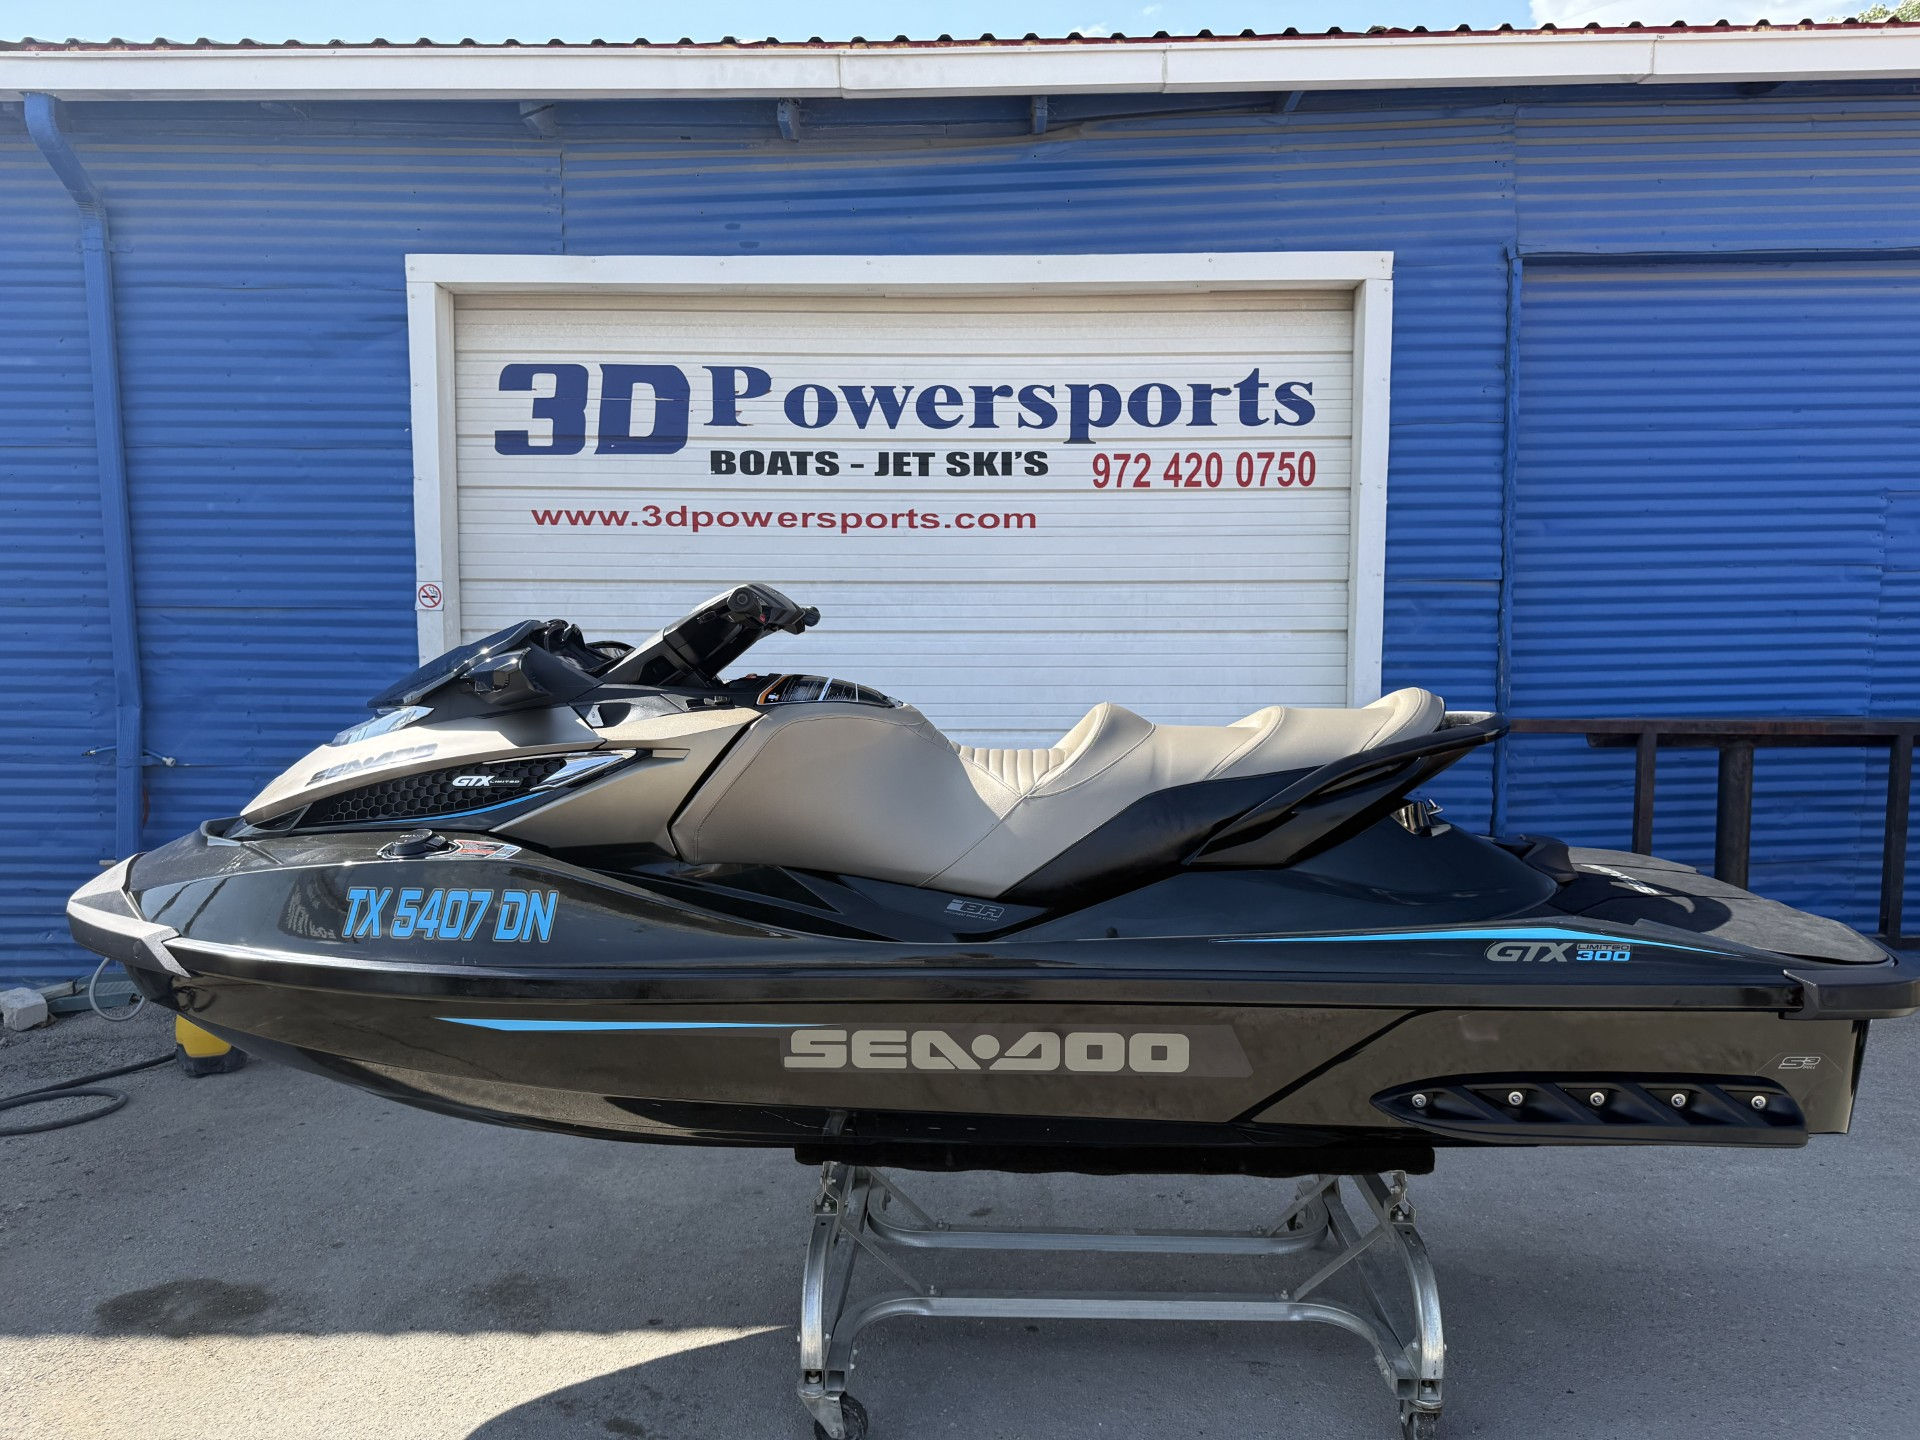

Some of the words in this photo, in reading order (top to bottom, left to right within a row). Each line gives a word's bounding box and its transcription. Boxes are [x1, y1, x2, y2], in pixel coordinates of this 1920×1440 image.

[495, 363, 691, 455] 3D
[702, 366, 1316, 444] Powersports
[710, 450, 839, 476] BOATS
[874, 451, 936, 477] JET
[946, 450, 1049, 477] SKI'S
[1092, 453, 1152, 489] 972
[1163, 452, 1223, 488] 420
[1236, 451, 1316, 487] 0750
[531, 505, 1037, 533] www.3dpowersports.com
[452, 775, 495, 787] GTX
[342, 887, 393, 938] TX
[391, 887, 494, 941] 5407
[493, 889, 559, 942] DN
[1485, 941, 1575, 963] GTX
[1575, 950, 1631, 962] 300
